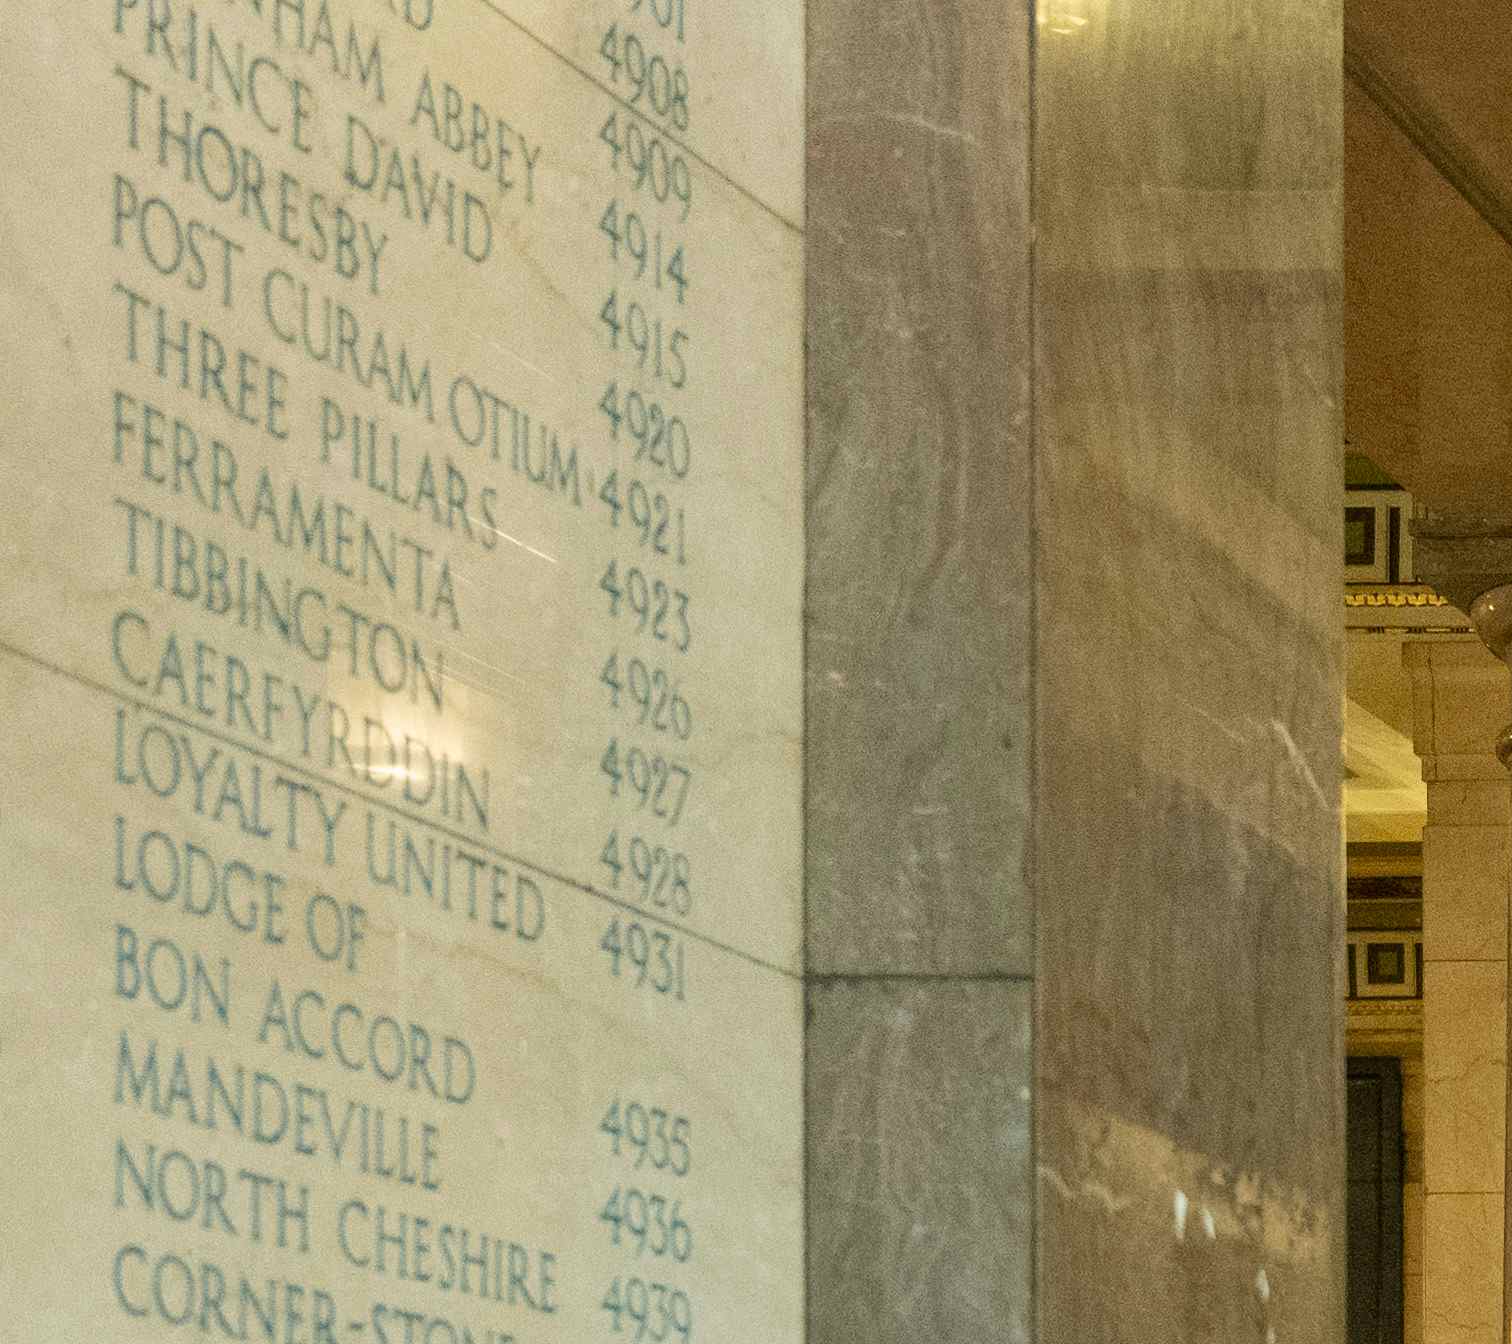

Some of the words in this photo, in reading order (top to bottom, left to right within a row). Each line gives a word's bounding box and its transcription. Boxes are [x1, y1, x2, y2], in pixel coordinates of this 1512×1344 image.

[410, 74, 541, 204] ABBEY
[600, 202, 689, 304] 4914
[600, 24, 691, 132] 4908
[600, 114, 693, 223] 4909
[113, 174, 245, 307] POST
[263, 269, 436, 423] CURAM
[448, 375, 583, 508] OTIUM
[600, 470, 687, 565] 4921
[114, 66, 389, 296] THORESBY
[600, 383, 691, 479] 4920
[345, 114, 495, 264] DAVID
[600, 290, 691, 389] 4915
[114, 283, 288, 442] THREE
[320, 396, 498, 551] PILLARS
[600, 560, 692, 654] 4923
[114, 391, 463, 633] FERRAMENTA
[600, 654, 692, 741] 4926
[112, 609, 492, 834] CAERFYRDDIN
[600, 829, 692, 916] 4928
[114, 496, 443, 714] TIBBINGTON
[600, 735, 692, 828] 4927
[114, 816, 285, 947] LODGE
[306, 894, 368, 974] OF
[115, 708, 347, 866] LOYALTY
[366, 811, 546, 943] UNITED
[600, 917, 687, 1002] 4931
[115, 925, 231, 1029] BON
[258, 979, 477, 1106] ACCORD
[600, 1098, 691, 1178] 4935
[115, 1032, 442, 1193] MANDEVILLE
[600, 1189, 692, 1264] 4936
[114, 1139, 309, 1255] NORTH
[338, 1200, 557, 1314] CHESHIRE
